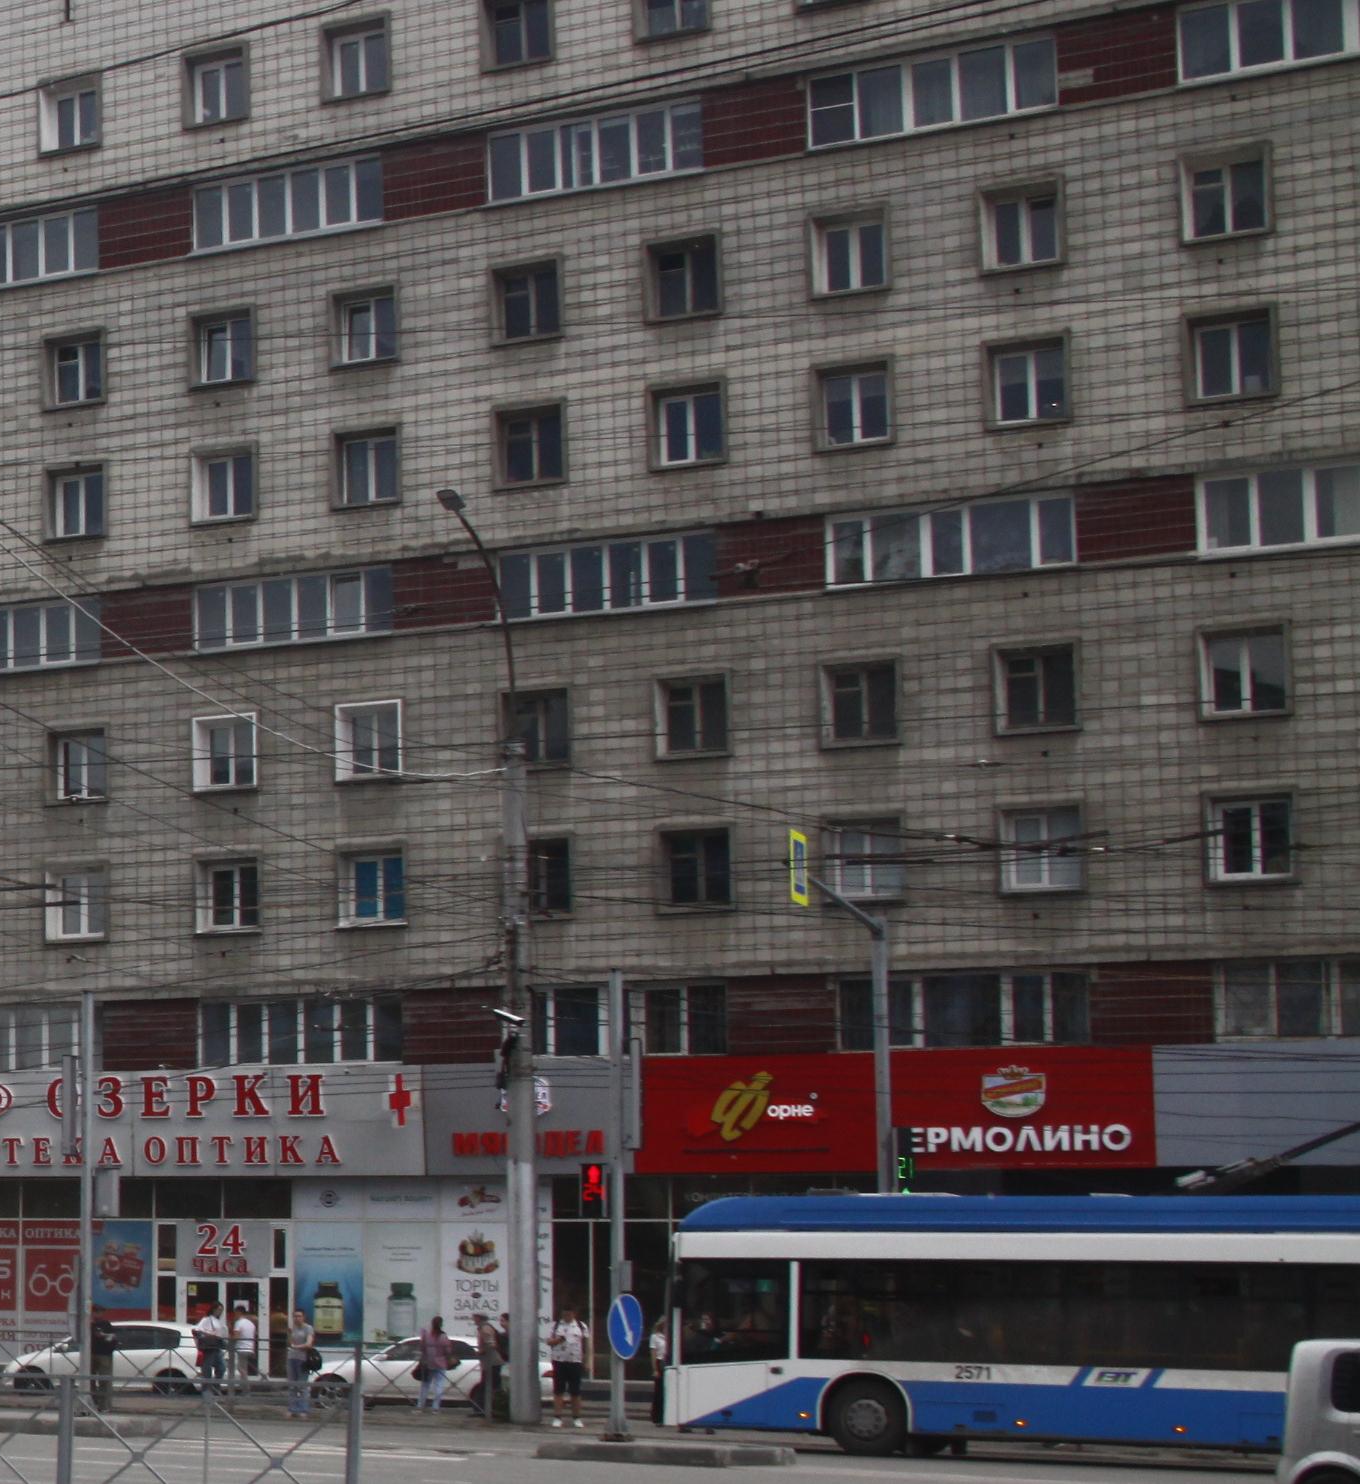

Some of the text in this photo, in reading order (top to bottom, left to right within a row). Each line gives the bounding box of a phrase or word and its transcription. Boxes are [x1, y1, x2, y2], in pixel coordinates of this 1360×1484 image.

[452, 1130, 605, 1158] МЯДЕЛ
[911, 1123, 1132, 1153] ЕРМОЛИНО
[143, 1135, 343, 1167] ОПТИКА
[25, 1228, 81, 1240] ОПТИКА
[196, 1223, 248, 1257] 24
[191, 1257, 251, 1275] часа
[454, 1279, 499, 1292] ТОРТЫ
[454, 1299, 499, 1312] ЗАКАЗ
[955, 1365, 991, 1380] 2571
